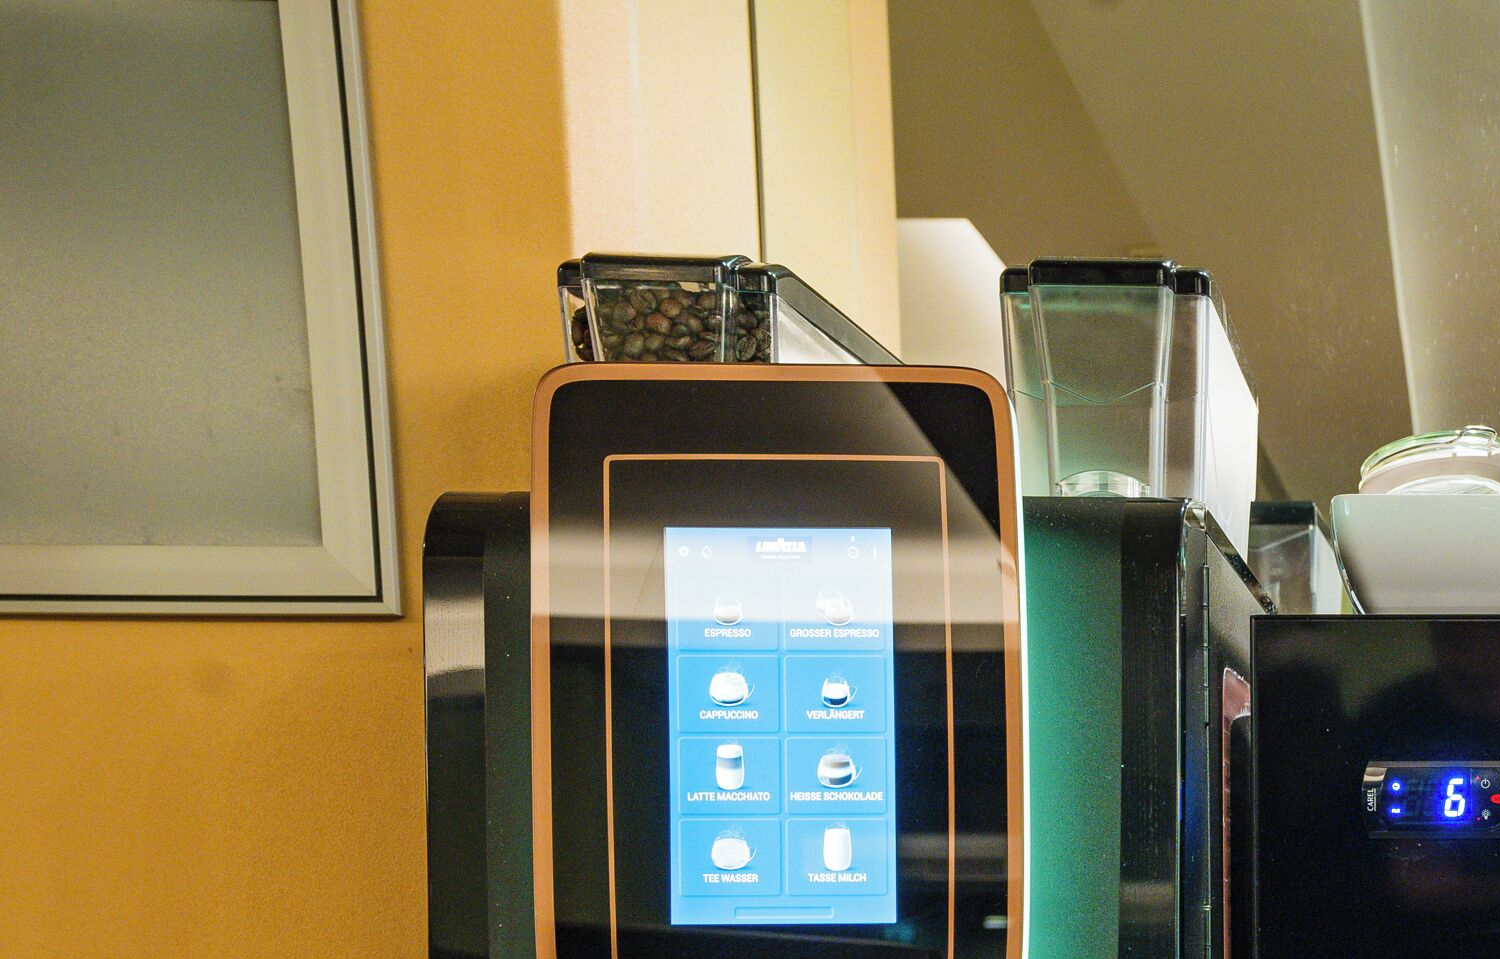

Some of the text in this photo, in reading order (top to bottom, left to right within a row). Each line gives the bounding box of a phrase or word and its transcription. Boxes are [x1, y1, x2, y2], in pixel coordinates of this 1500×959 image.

[704, 628, 751, 638] ESPRESSO
[790, 628, 880, 638] GROSSER ESPRESSO
[699, 710, 758, 720] CAPPUCCINO
[806, 708, 865, 720] VERLÄNGERT
[687, 791, 770, 801] LATTE MACCHIATO
[790, 791, 883, 801] HEISSE SCHOKOLADE
[1443, 777, 1466, 818] 6
[703, 873, 759, 883] TEE WASSER
[808, 873, 867, 883] TASSE MILCH
